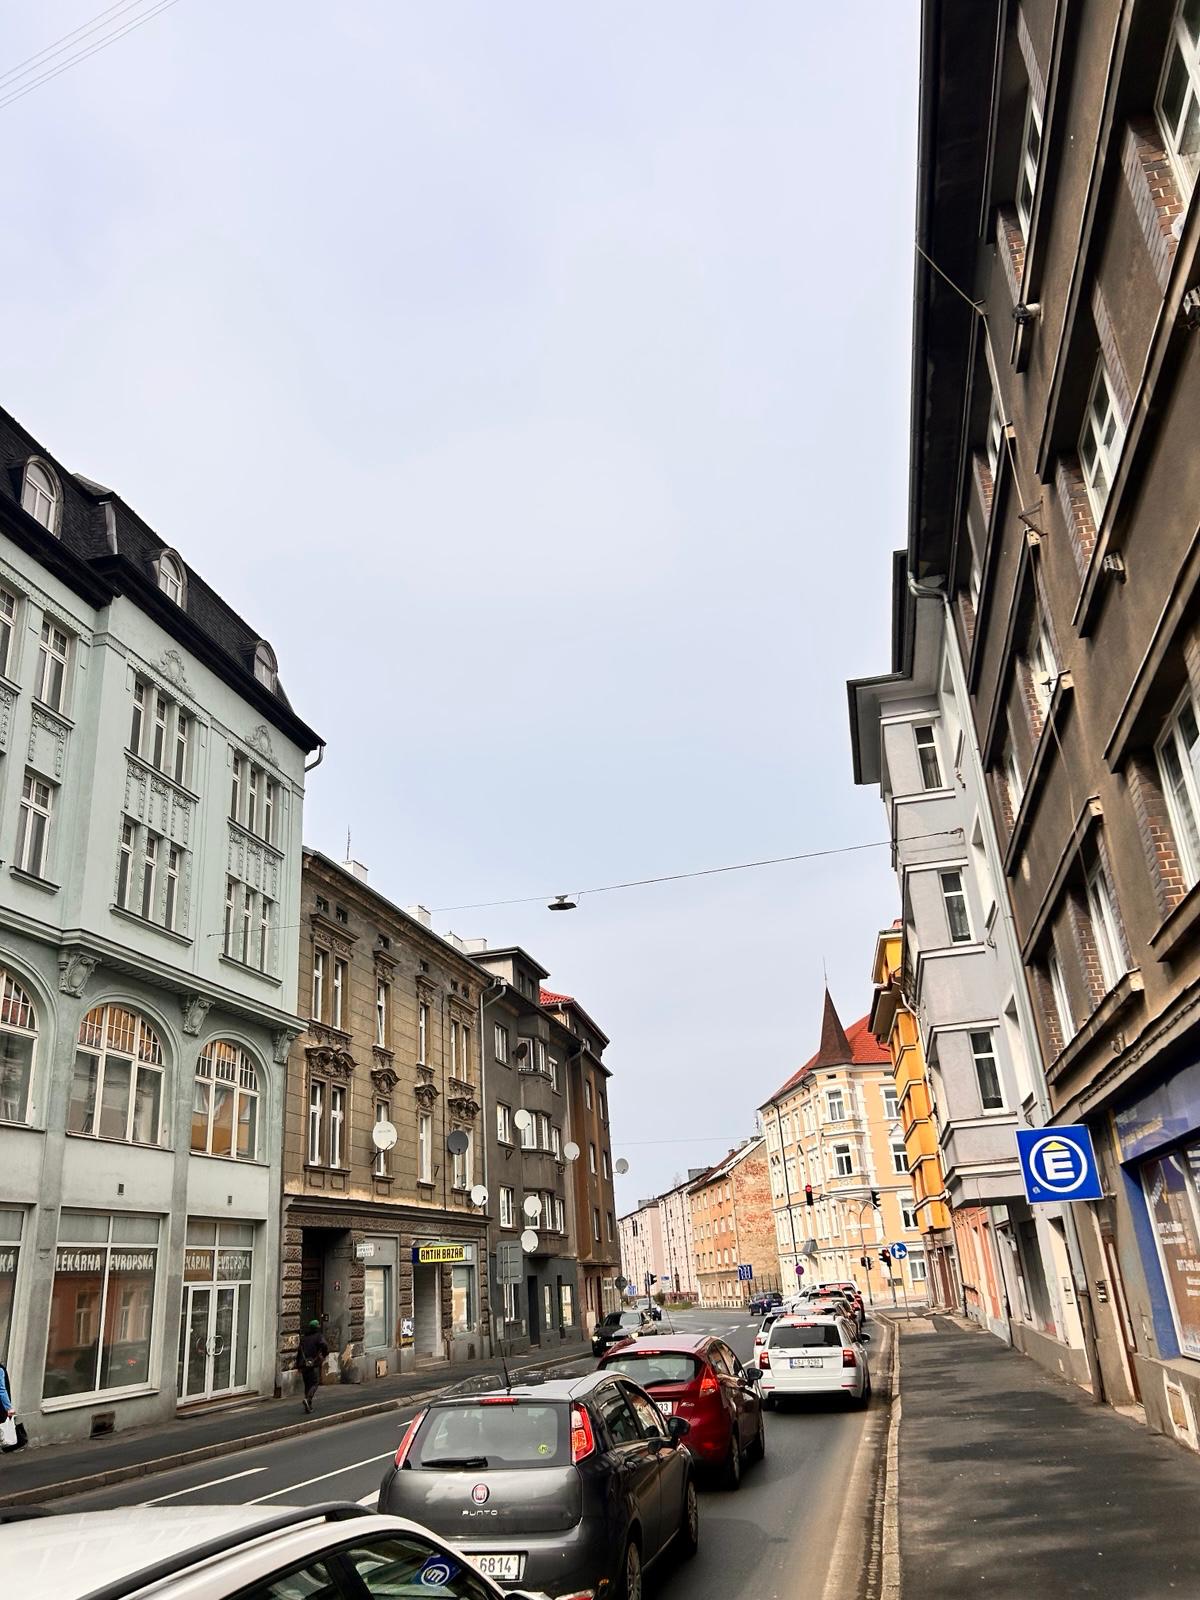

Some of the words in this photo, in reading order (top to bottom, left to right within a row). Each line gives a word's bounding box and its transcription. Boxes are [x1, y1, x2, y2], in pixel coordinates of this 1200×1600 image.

[0, 1249, 14, 1272] KÁ
[56, 1250, 101, 1271] LÉKÁRNA
[109, 1251, 154, 1270] EVROPSKÁ
[185, 1252, 210, 1270] KÁRNA
[421, 1249, 441, 1260] ANTIK
[442, 1247, 464, 1259] BAZAR
[480, 1557, 512, 1573] 6814
